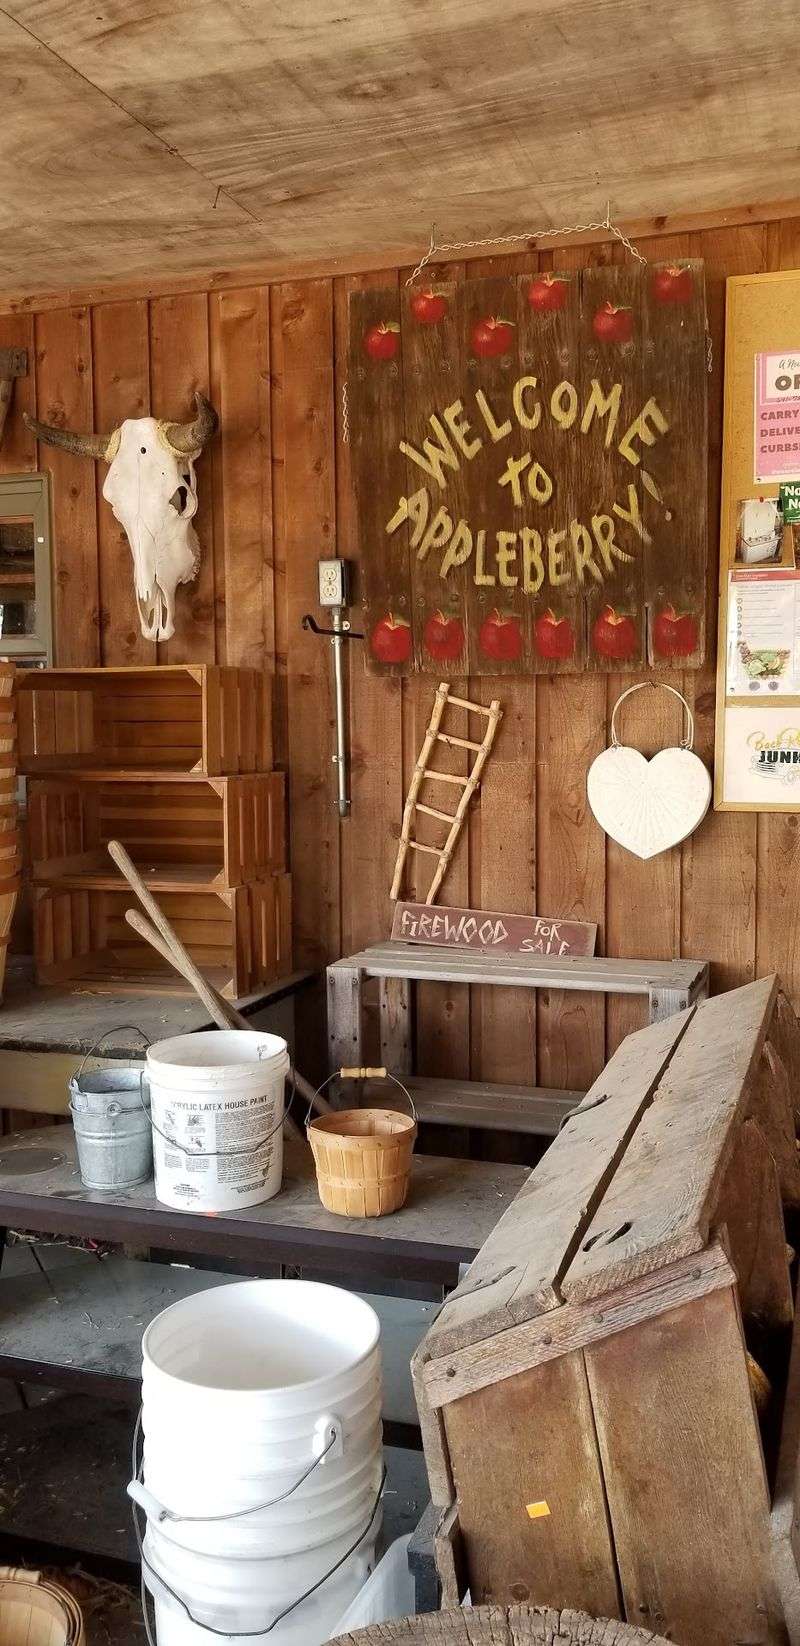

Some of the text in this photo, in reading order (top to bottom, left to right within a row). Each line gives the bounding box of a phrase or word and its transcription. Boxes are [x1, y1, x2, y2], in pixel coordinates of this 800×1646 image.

[399, 376, 670, 490] WELCOME
[386, 470, 673, 594] APPLEBERRY!
[199, 1103, 223, 1111] LATEX
[224, 1099, 249, 1110] HOUSE
[249, 1094, 269, 1106] PAINT
